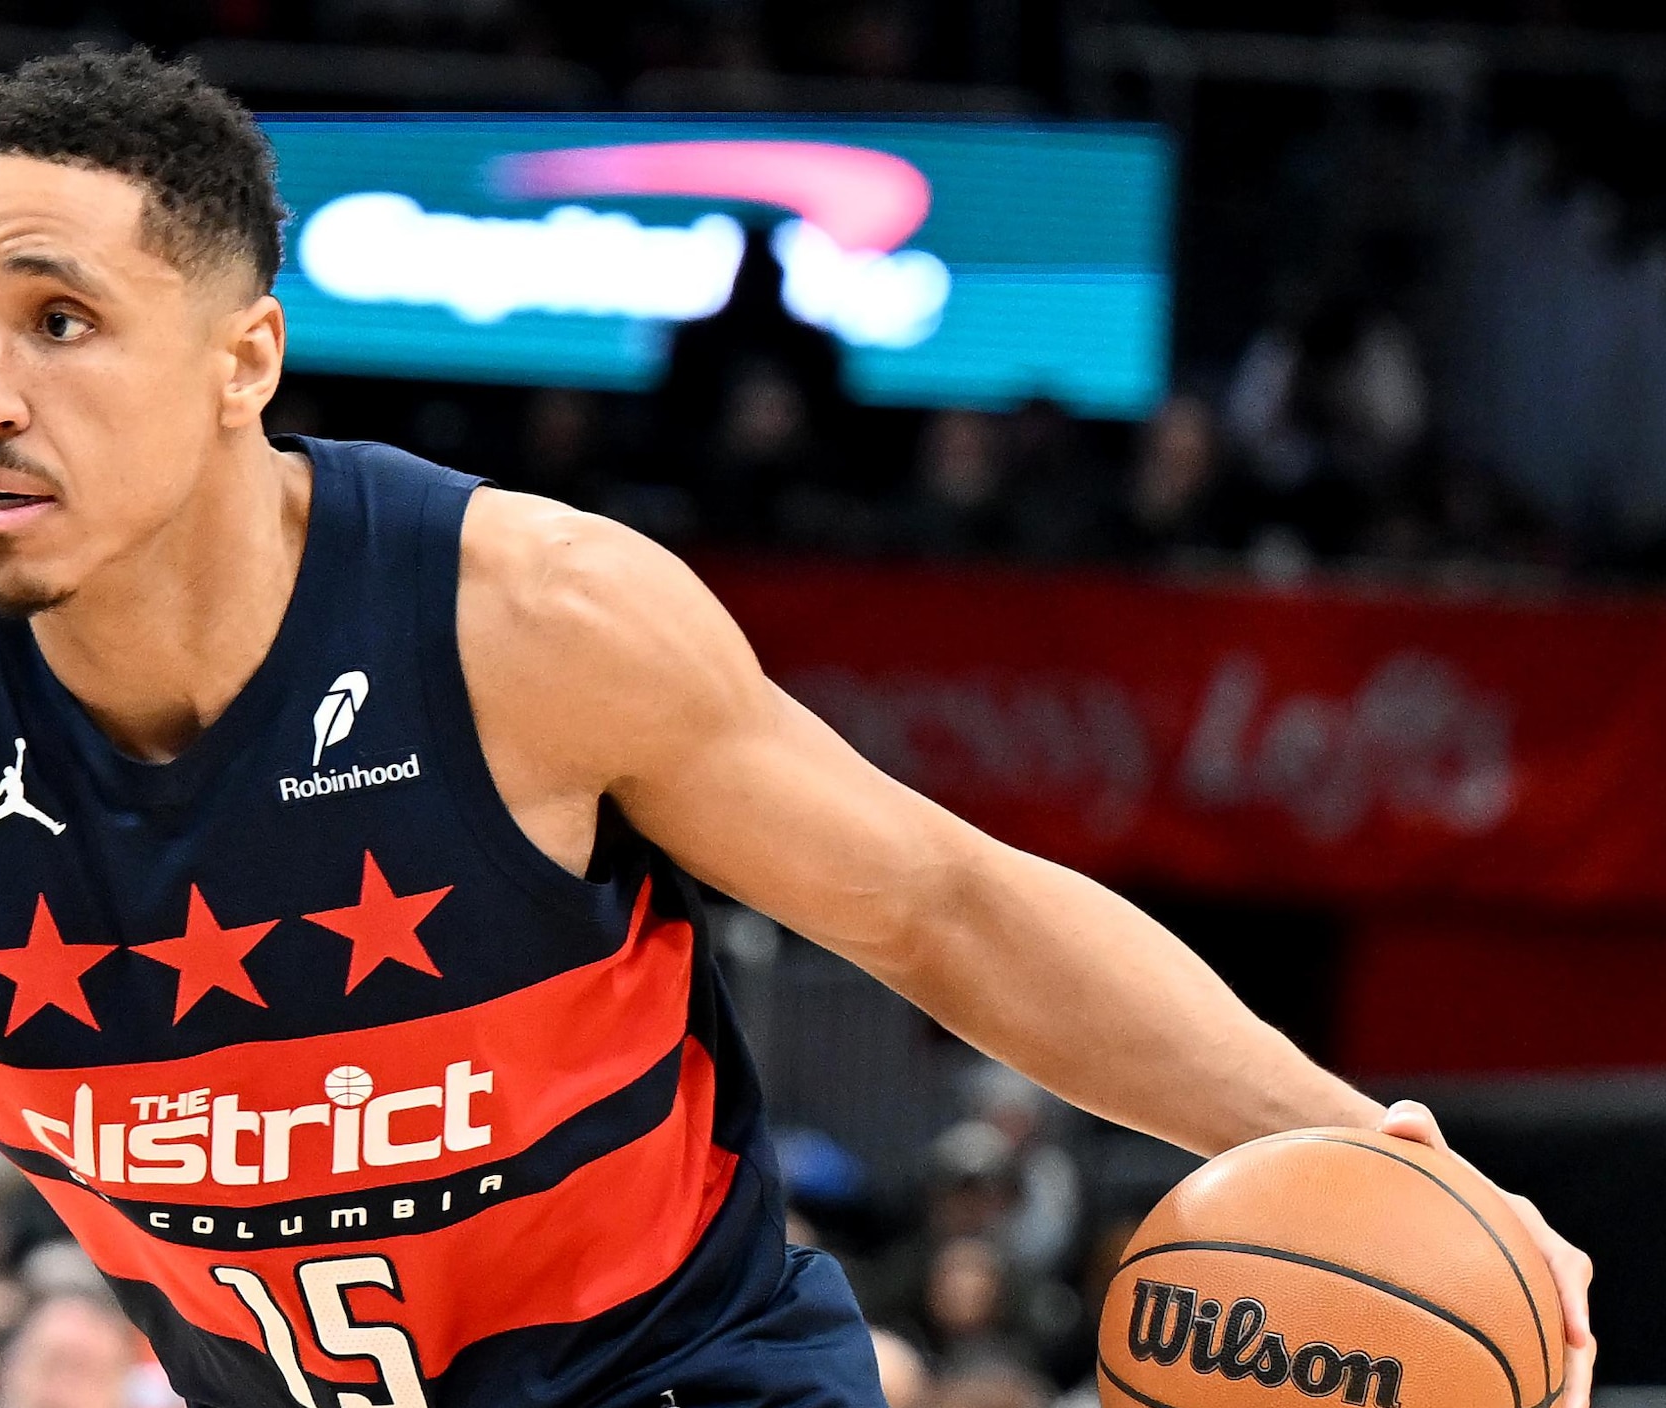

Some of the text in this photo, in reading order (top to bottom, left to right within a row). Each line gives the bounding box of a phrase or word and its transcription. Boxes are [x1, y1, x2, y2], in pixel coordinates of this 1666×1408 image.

[279, 753, 421, 801] Robinhood
[22, 1060, 494, 1185] district
[130, 1087, 211, 1121] THE
[149, 1173, 503, 1239] COLUMBIA
